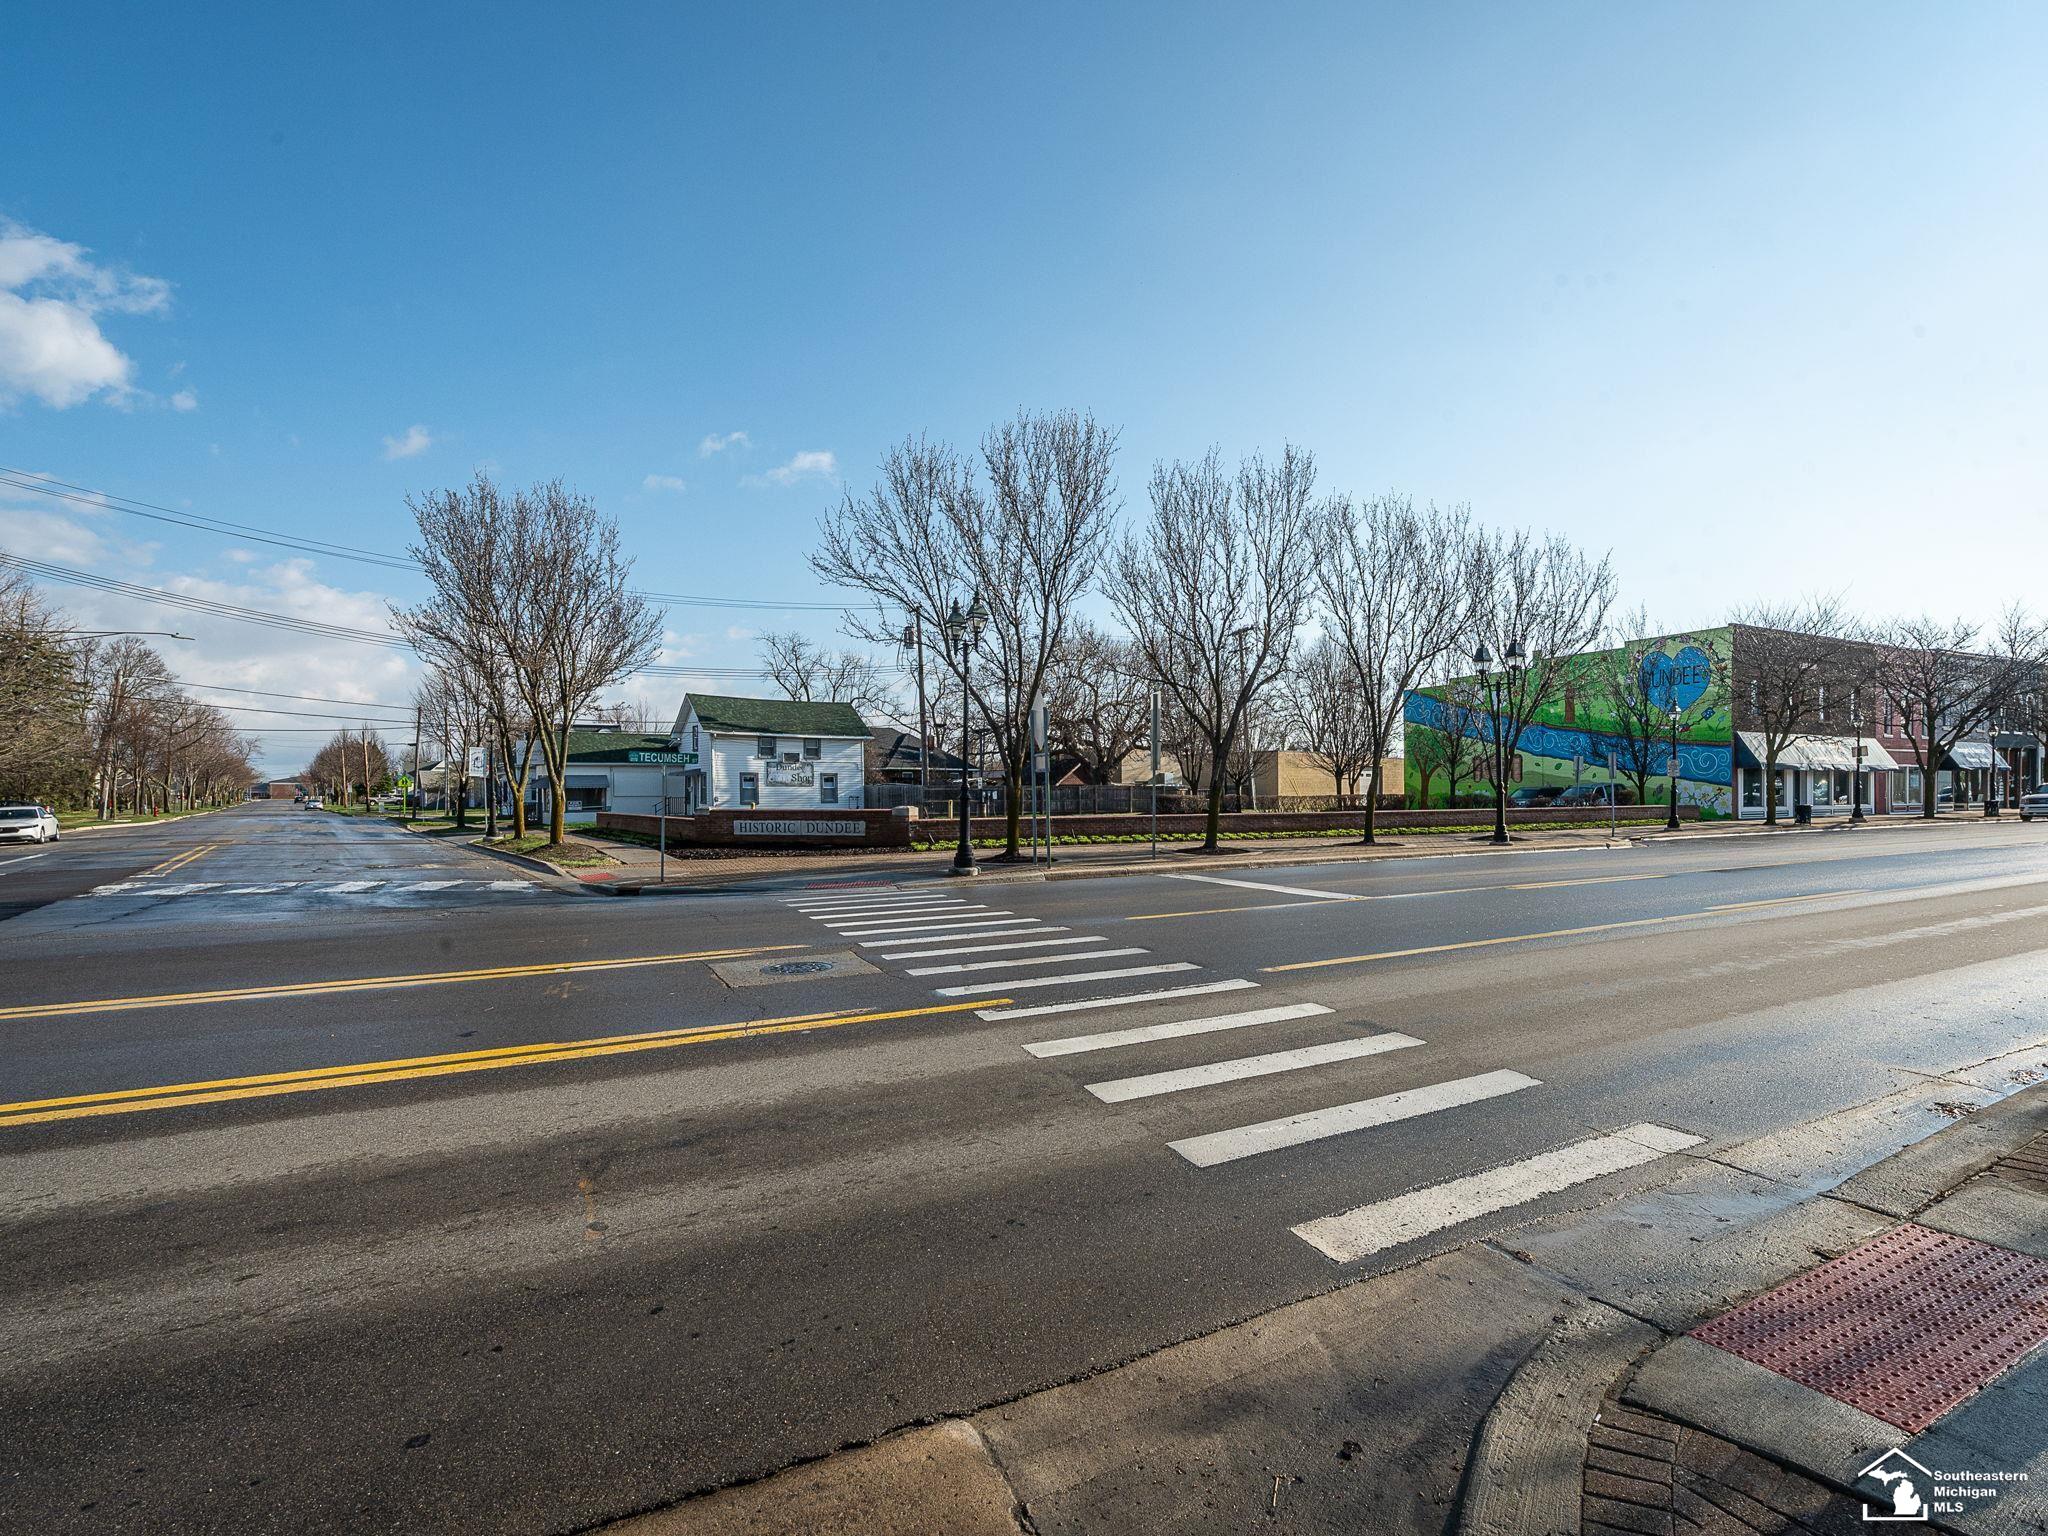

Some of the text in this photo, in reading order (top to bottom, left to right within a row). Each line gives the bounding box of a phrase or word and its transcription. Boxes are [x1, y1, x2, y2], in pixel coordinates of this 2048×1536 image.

[639, 752, 690, 763] TECUMSEH
[739, 822, 861, 834] HISTORIC DUNDEE
